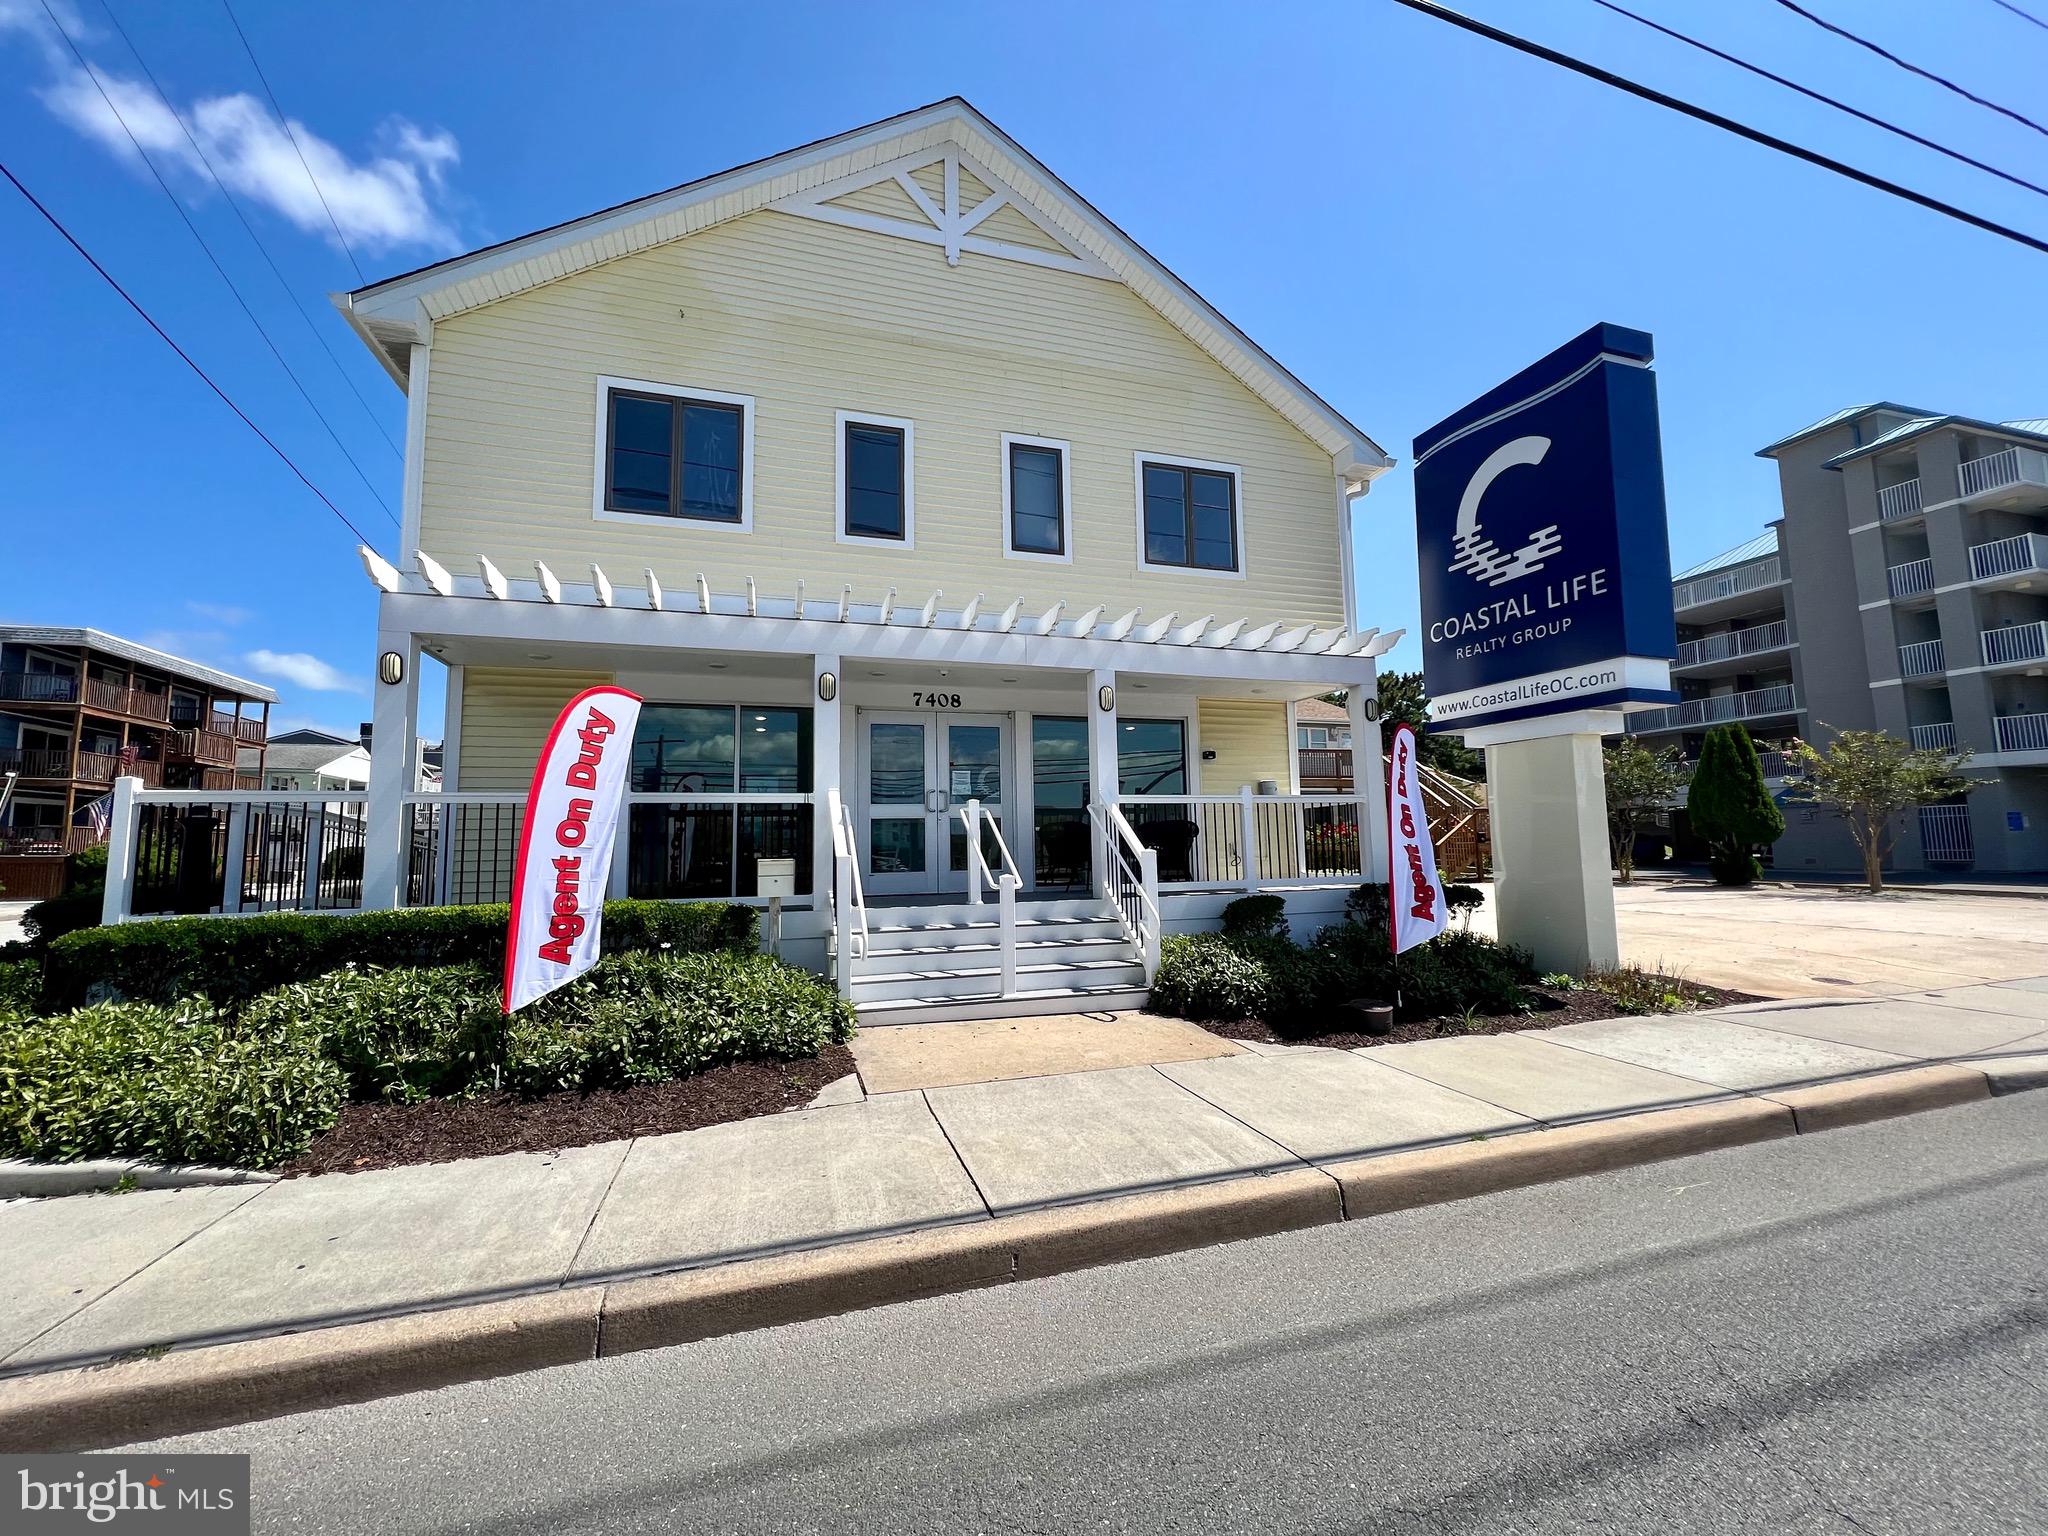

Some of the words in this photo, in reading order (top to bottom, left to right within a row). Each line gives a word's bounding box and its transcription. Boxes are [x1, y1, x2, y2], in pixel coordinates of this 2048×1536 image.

[1430, 594, 1536, 643] COASTAL
[1547, 568, 1608, 609] LIFE
[1456, 635, 1507, 660] REALTY
[1513, 618, 1572, 645] GROUP
[912, 692, 962, 708] 7408
[1437, 669, 1617, 716] www.CoastalLifeOC.com
[566, 706, 616, 791] Duty
[556, 798, 593, 848] On
[1400, 803, 1416, 839] On
[1404, 843, 1436, 923] Agent
[538, 856, 585, 966] Agent
